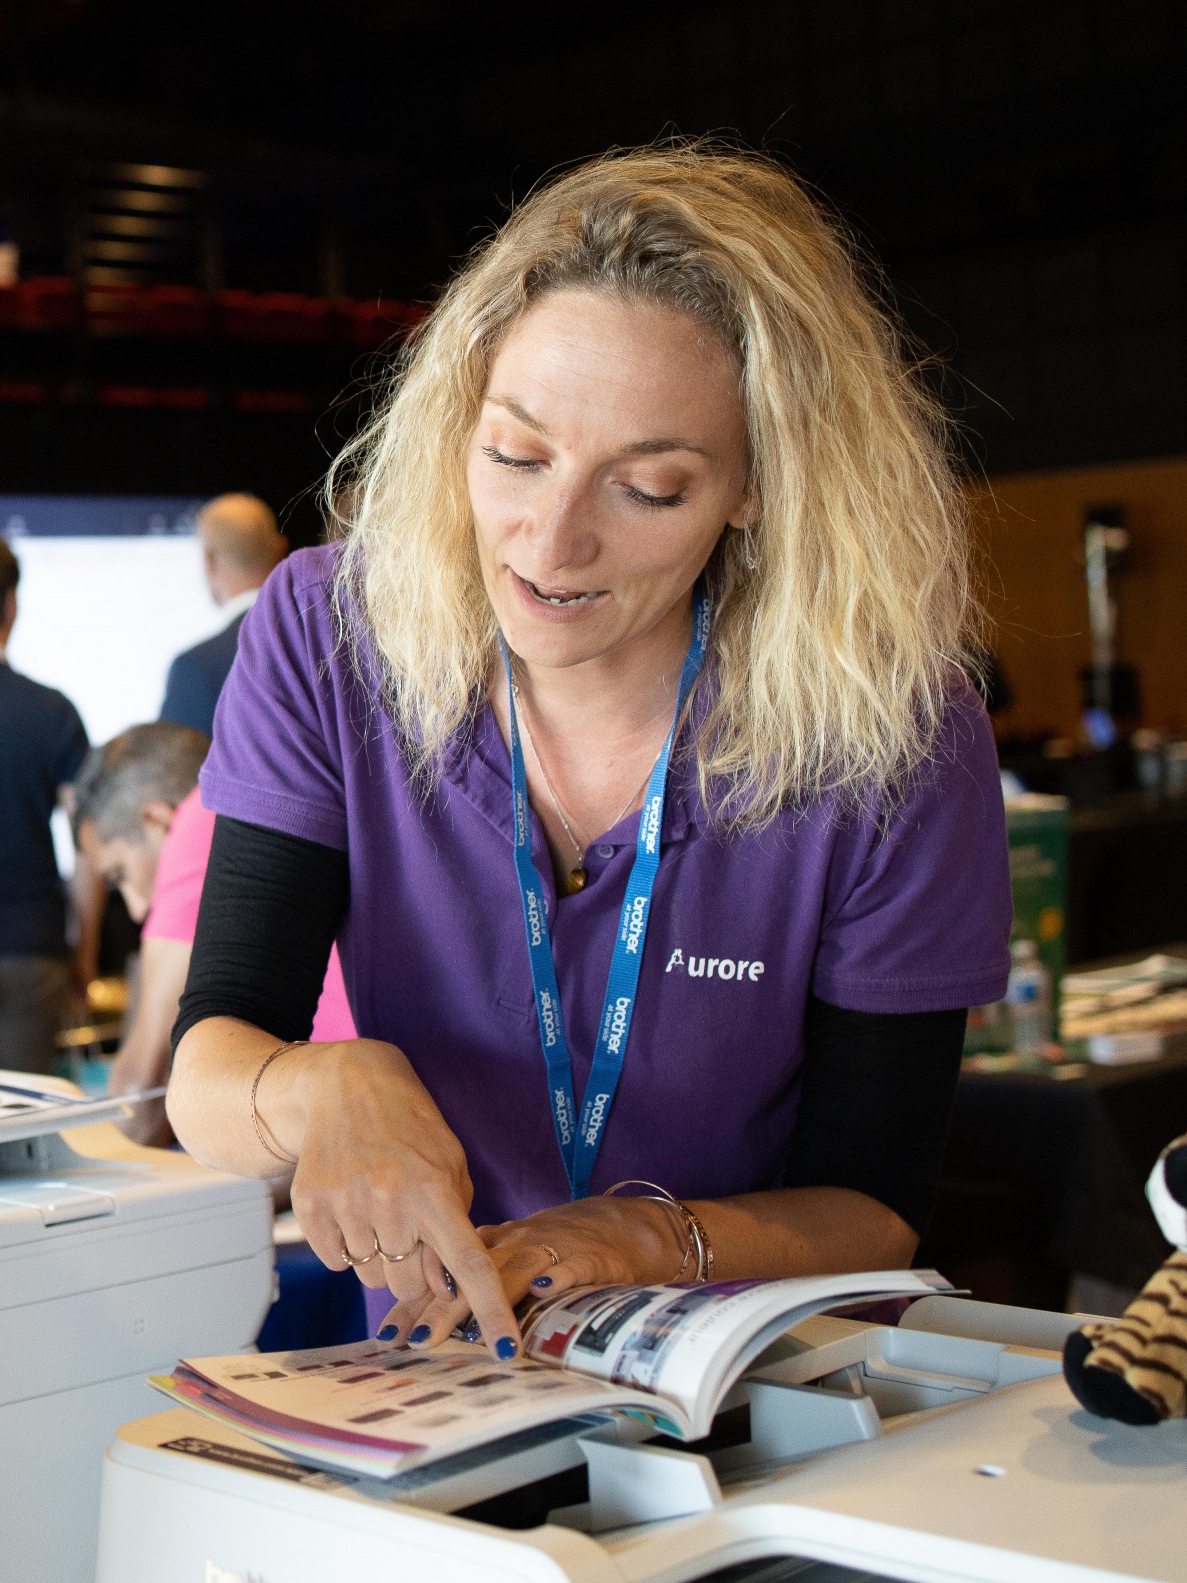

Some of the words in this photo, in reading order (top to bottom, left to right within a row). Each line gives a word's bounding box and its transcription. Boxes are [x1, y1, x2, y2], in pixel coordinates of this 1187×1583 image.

[645, 796, 662, 854] brother
[526, 888, 542, 946] brother
[626, 896, 648, 954] brother
[665, 948, 765, 981] Aurore
[539, 988, 556, 1046] brother
[607, 997, 632, 1054] brother
[554, 1087, 571, 1145] brother
[585, 1093, 610, 1147] brother
